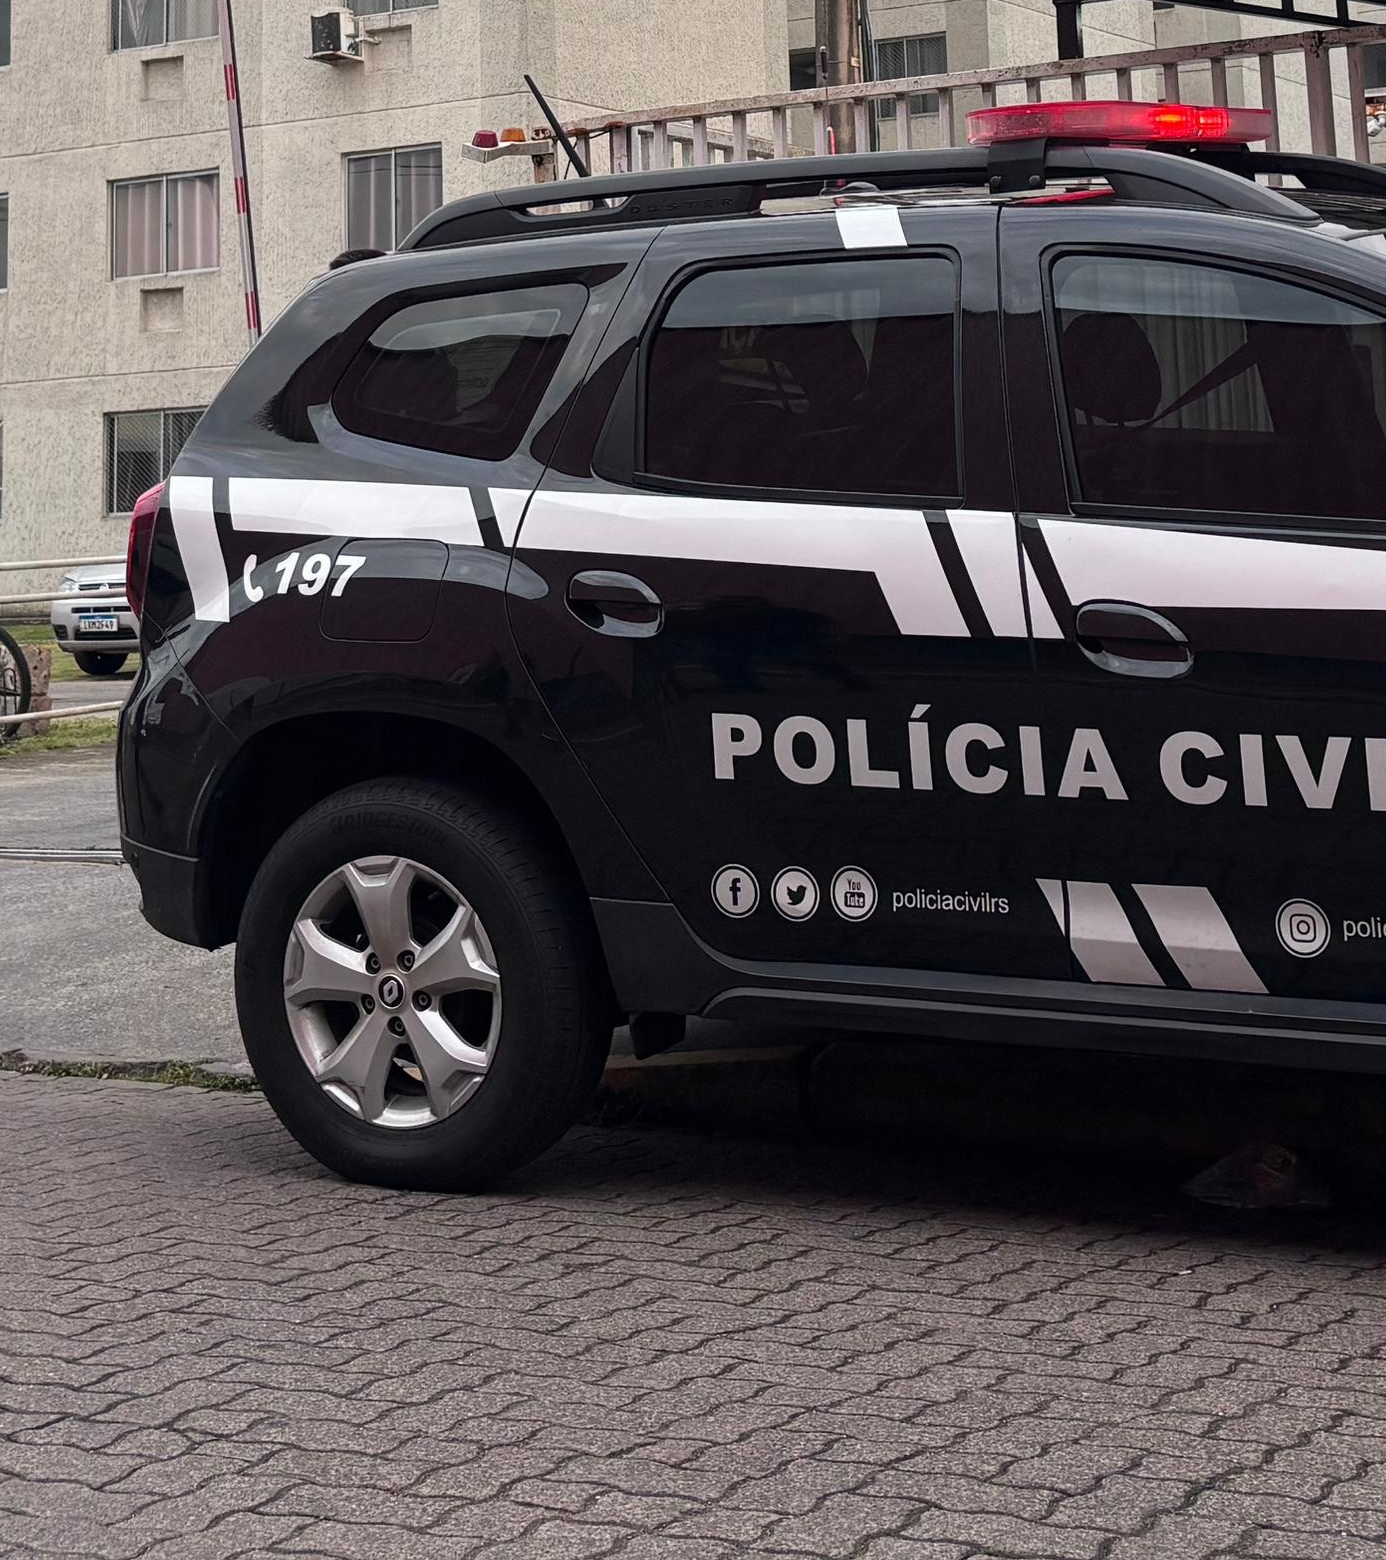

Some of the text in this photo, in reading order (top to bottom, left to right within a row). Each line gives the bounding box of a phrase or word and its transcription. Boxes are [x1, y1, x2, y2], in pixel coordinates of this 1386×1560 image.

[629, 198, 733, 214] DUSTER
[275, 552, 366, 597] 197
[711, 704, 1129, 800] POLÍCIA
[892, 889, 1009, 914] policiacivilrs
